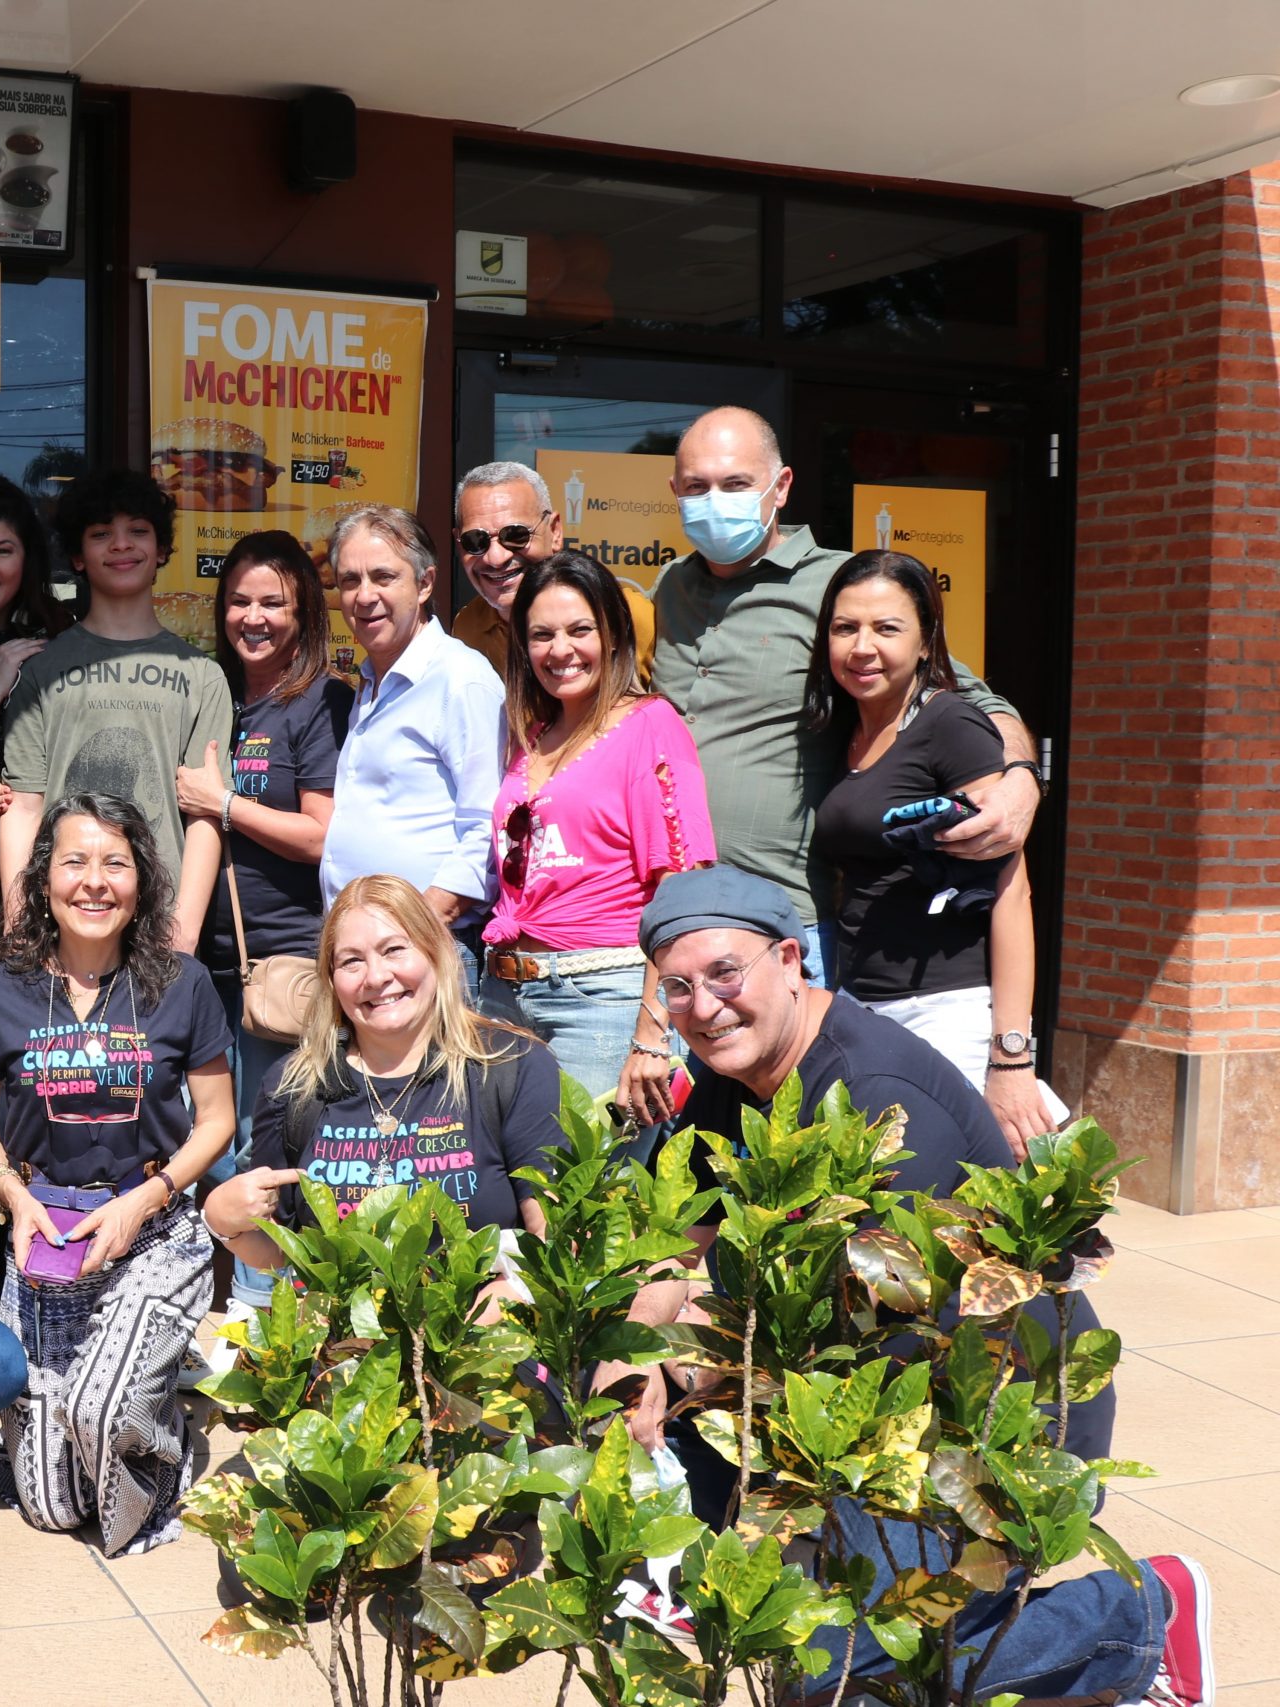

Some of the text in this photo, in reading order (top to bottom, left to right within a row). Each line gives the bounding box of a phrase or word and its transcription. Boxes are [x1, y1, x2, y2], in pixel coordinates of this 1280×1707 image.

[0, 90, 66, 106] MAIS SABOR NA
[0, 102, 67, 117] SUA SOBREMESA
[184, 301, 392, 370] FOME de
[184, 360, 390, 416] McCHICKEN
[292, 432, 384, 450] McChicken Barbecue
[587, 498, 677, 517] McProtegidos
[197, 526, 248, 539] McChicken
[894, 529, 964, 546] McProtegidos
[56, 662, 190, 698] JOHN JOHN
[88, 700, 164, 713] WALKING AWAY
[30, 1022, 108, 1039] ACREDITAR
[23, 1050, 153, 1070] CURAR VIVER
[52, 1069, 90, 1080] PERMITIR
[35, 1080, 97, 1097] SORRIR
[417, 1122, 464, 1136] BRINCAR
[417, 1134, 467, 1154] CRESCER
[414, 1151, 474, 1174] VIVER
